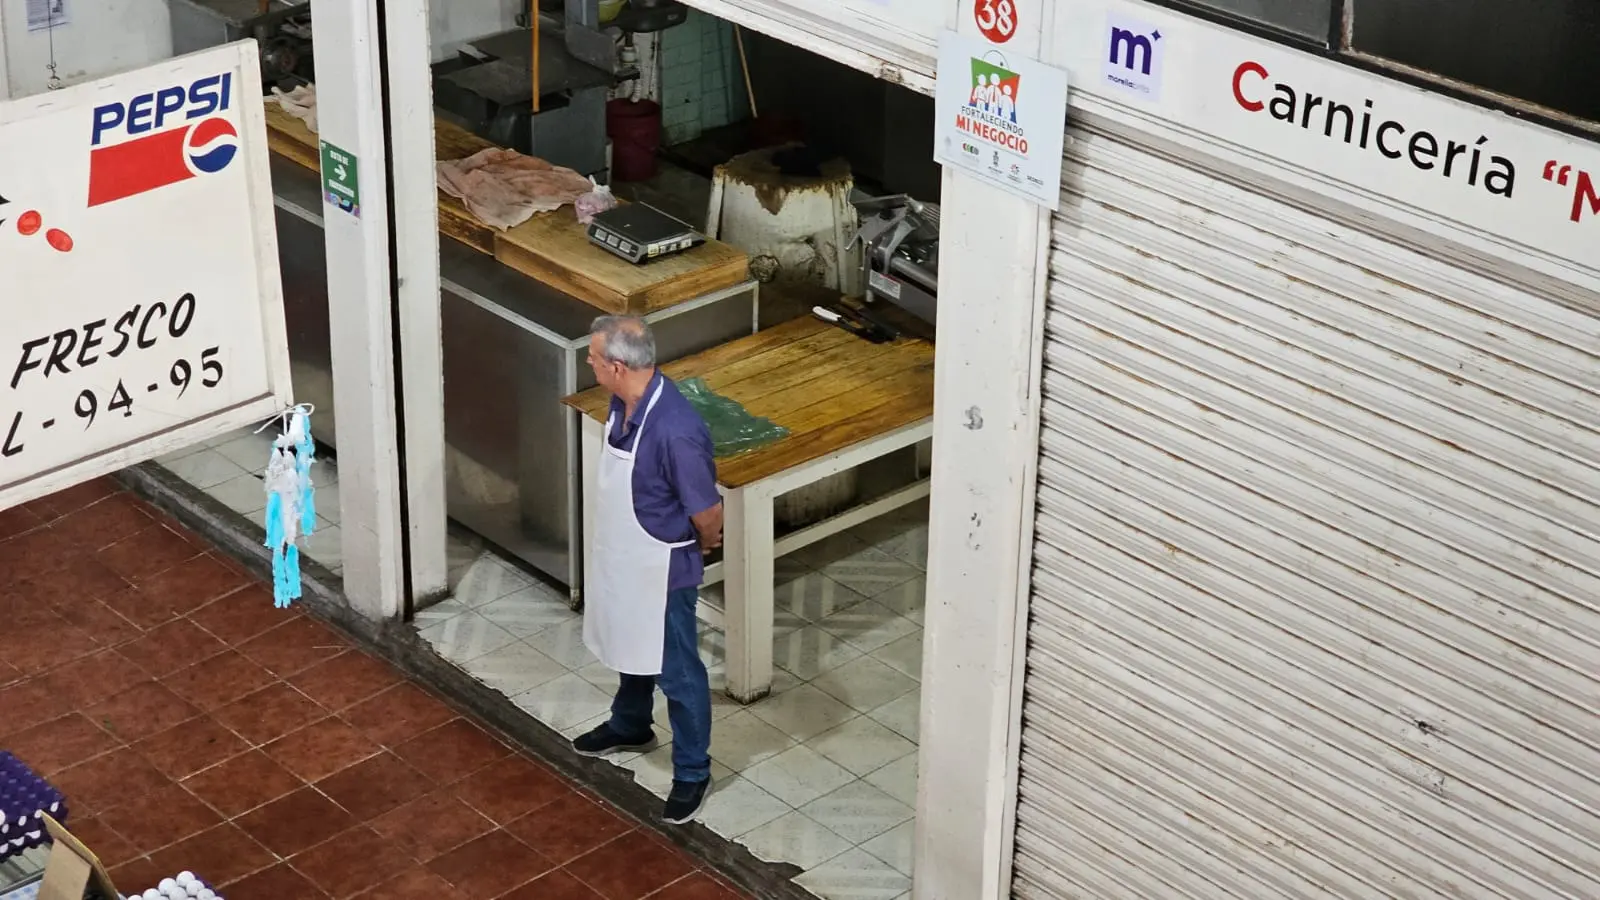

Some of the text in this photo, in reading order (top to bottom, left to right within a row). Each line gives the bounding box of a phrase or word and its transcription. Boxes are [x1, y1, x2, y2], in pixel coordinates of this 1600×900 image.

[977, 0, 1013, 37] 38
[90, 71, 232, 146] PEPSI
[956, 114, 970, 132] MI
[972, 120, 1029, 154] NEGOCIO
[961, 105, 1024, 137] FORTALECIENDO
[1232, 60, 1516, 199] Carnicería
[10, 292, 197, 390] FRESCO
